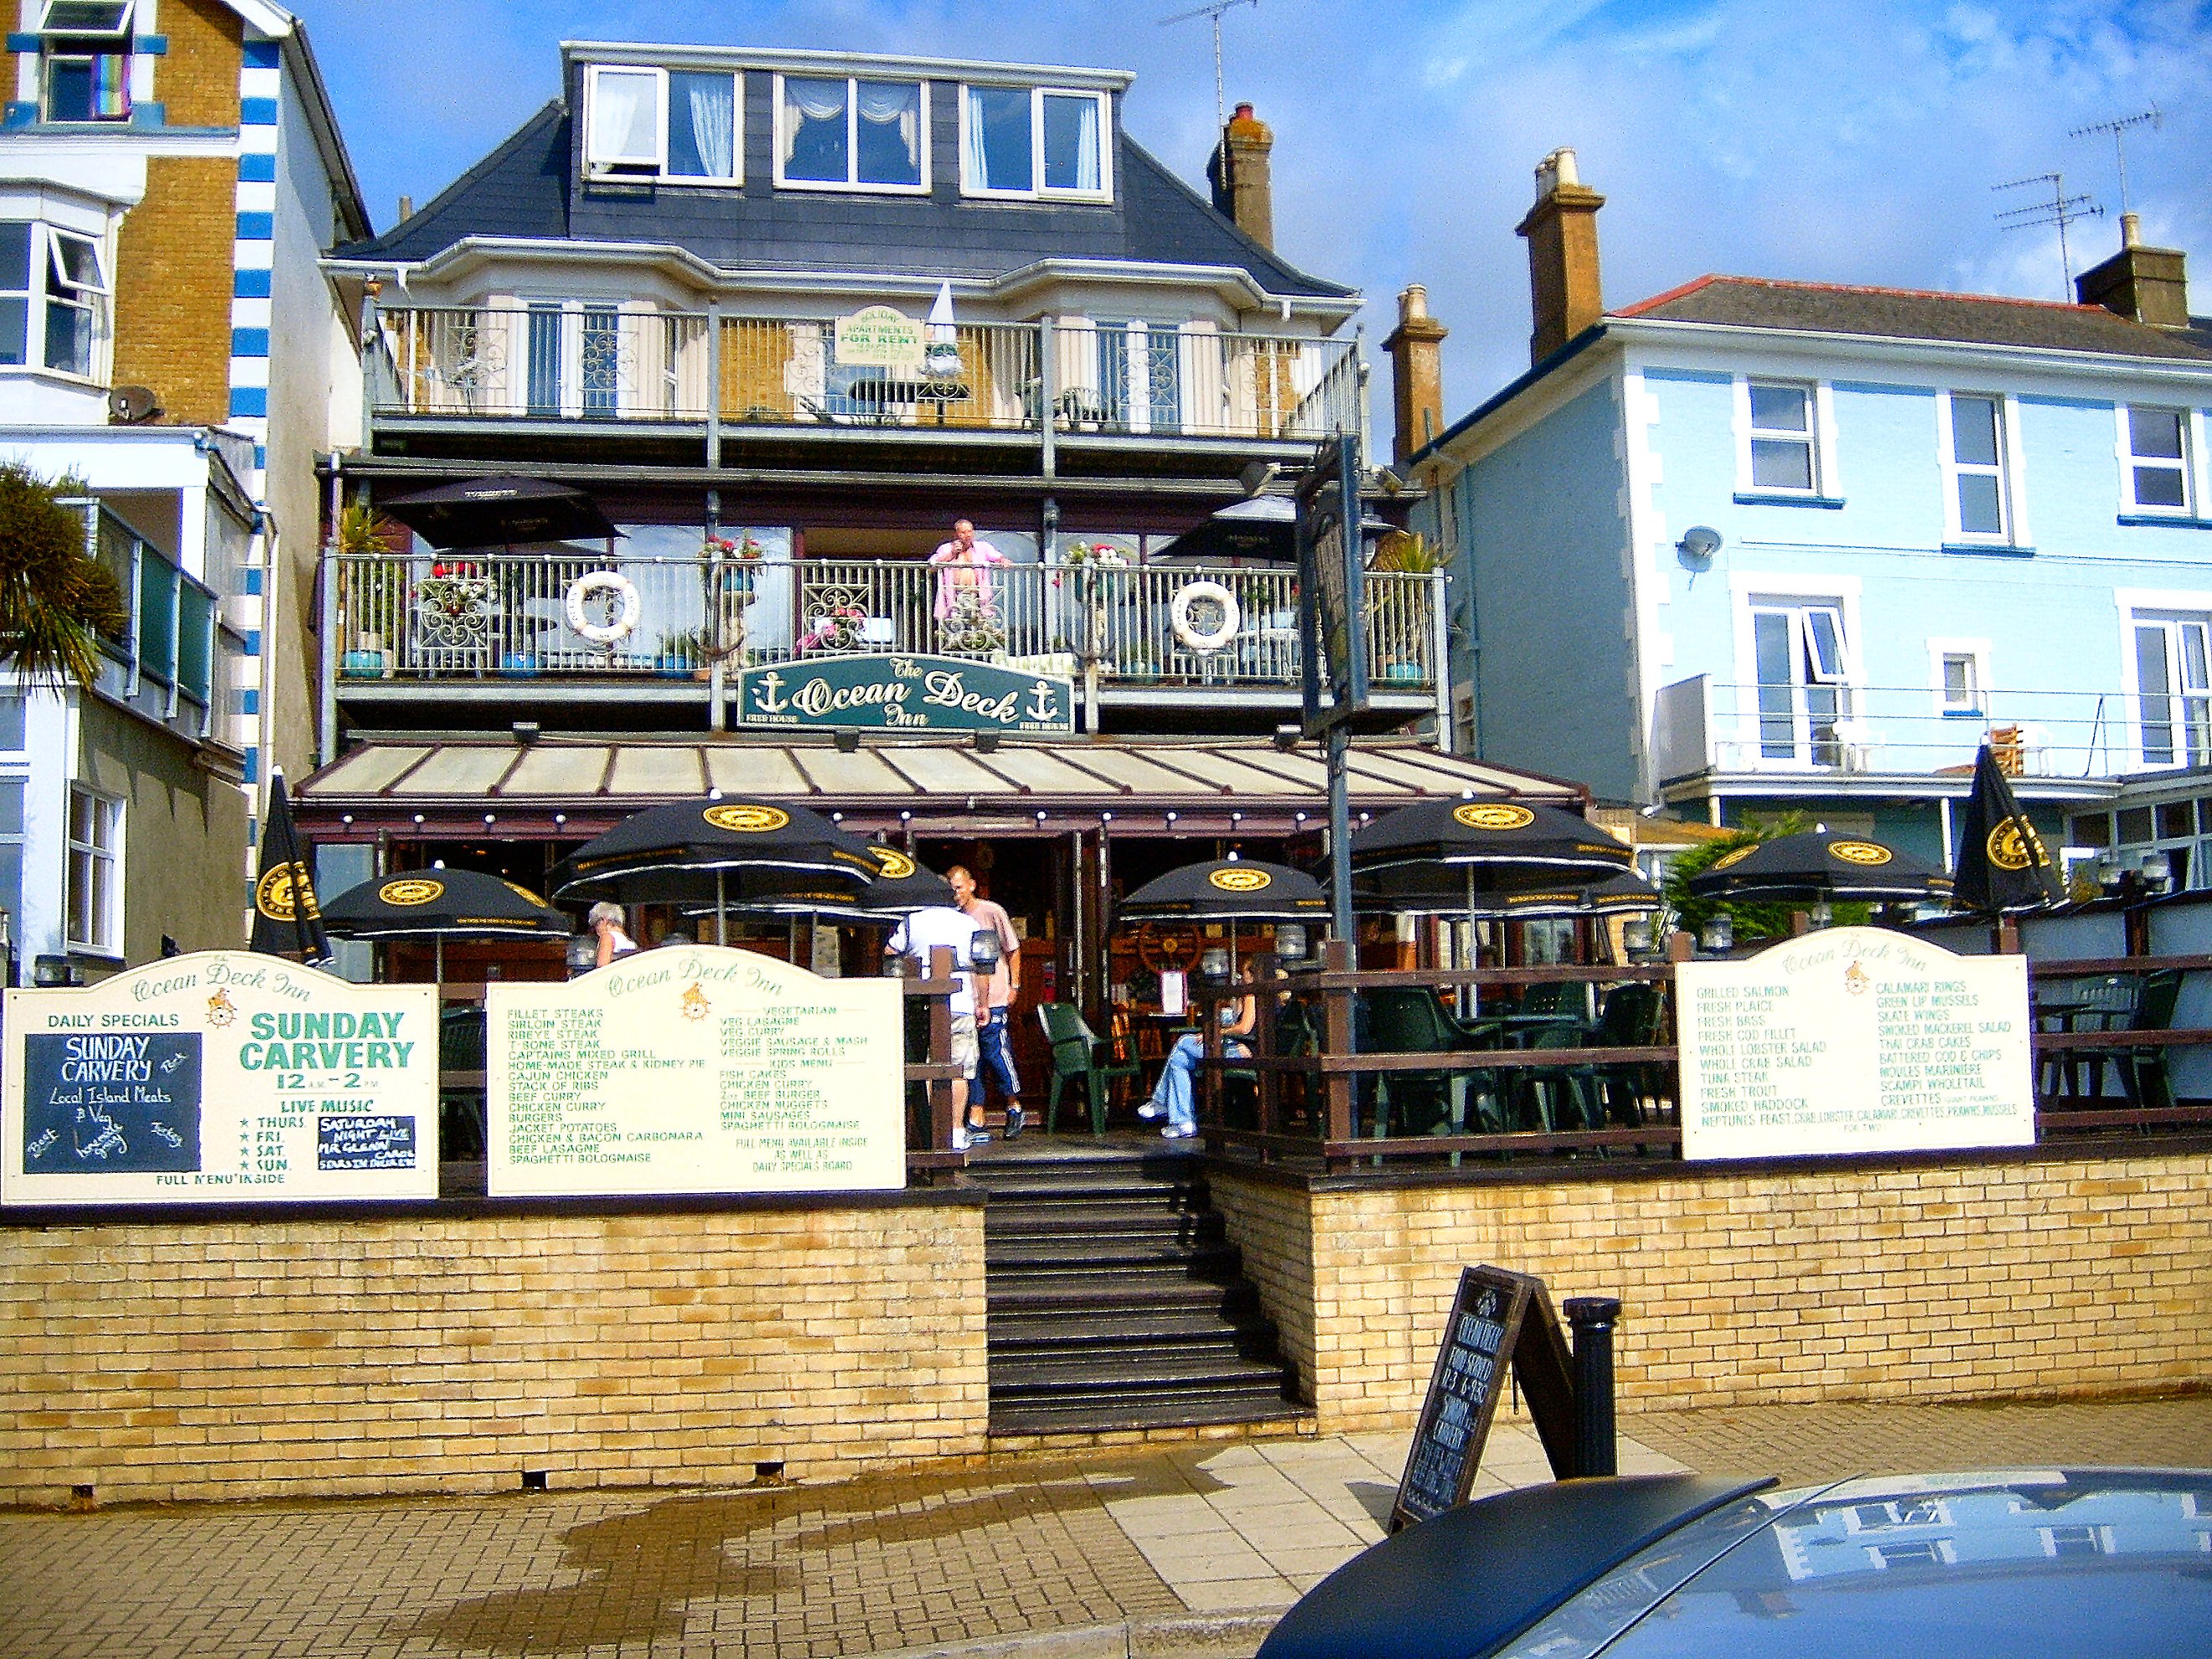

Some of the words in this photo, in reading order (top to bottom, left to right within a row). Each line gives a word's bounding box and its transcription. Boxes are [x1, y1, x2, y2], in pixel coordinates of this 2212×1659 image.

[840, 334, 870, 343] FOR
[877, 335, 918, 344] RENT
[889, 658, 923, 678] The
[791, 677, 912, 717] Ocean
[923, 669, 1020, 725] Deck
[884, 703, 929, 726] Inn
[1842, 939, 1890, 958] Deck
[1897, 947, 1926, 971] Inn
[131, 974, 198, 1002] Ocean
[206, 964, 266, 988] Deck
[272, 973, 313, 1002] Inn
[606, 969, 671, 998] Ocean
[678, 959, 738, 981] Deck
[746, 967, 783, 997] Inn
[1697, 987, 1739, 999] GRILLED
[1744, 986, 1789, 997] SALMON
[762, 1006, 837, 1016] VEGETARIAN
[1697, 1001, 1731, 1013] FRESH
[507, 1009, 548, 1019] FILLET
[555, 1009, 603, 1019] STEAKS
[48, 1015, 94, 1027] DAILY
[101, 1014, 179, 1026] SPECIALS
[251, 1012, 405, 1041] SUNDAY
[508, 1020, 555, 1030] SIRLOIN
[561, 1019, 602, 1029] STEAK
[1736, 1016, 1765, 1026] BASS
[1978, 1021, 2011, 1033] SALAD
[507, 1030, 550, 1040] RIBEYE
[556, 1030, 597, 1039] STEAK
[1698, 1031, 1732, 1041] FRESH
[1738, 1030, 1759, 1041] COD
[561, 1040, 601, 1049] STEAK
[720, 1038, 761, 1047] VEGGIE
[767, 1037, 819, 1047] SAUSAGE
[835, 1036, 867, 1046] MASH
[65, 1036, 151, 1061] SUNDAY
[720, 1048, 761, 1057] VEGGIE
[767, 1047, 804, 1057] SPRING
[810, 1047, 845, 1056] ROLLS
[1741, 1043, 1787, 1055] LOBSTER
[1791, 1041, 1827, 1053] SALAD
[239, 1041, 415, 1071] CARVERY
[576, 1050, 615, 1060] MIXED
[621, 1049, 656, 1059] GRILL
[1972, 1049, 2002, 1061] CHIPS
[507, 1061, 582, 1071] HOME-MADE
[587, 1060, 626, 1070] STEAK
[643, 1060, 685, 1069] KIDNEY
[689, 1059, 706, 1068] PIE
[769, 1060, 795, 1069] KIDS
[800, 1059, 833, 1068] MENU
[1776, 1056, 1812, 1067] SALAD
[62, 1060, 152, 1082] CARVERY
[508, 1072, 550, 1081] CAJUN
[556, 1071, 608, 1081] CHICKEN
[720, 1070, 744, 1079] FISH
[749, 1070, 787, 1079] CAKES
[276, 1073, 306, 1089] 12
[344, 1072, 361, 1088] 2
[1701, 1073, 1730, 1084] TUNA
[1734, 1072, 1769, 1083] STEAK
[509, 1082, 546, 1092] STACK
[552, 1082, 567, 1091] OF
[572, 1081, 599, 1091] RIBS
[720, 1080, 769, 1090] CHICKEN
[774, 1080, 813, 1089] CURRY
[49, 1087, 83, 1104] Local
[87, 1087, 130, 1103] Island
[134, 1086, 172, 1103] Meats
[509, 1093, 537, 1102] BEEF
[543, 1092, 581, 1102] CURRY
[744, 1091, 770, 1099] BEEF
[775, 1090, 820, 1099] BURGER
[1701, 1087, 1736, 1098] FRESH
[1741, 1085, 1777, 1097] TROUT
[720, 1101, 769, 1110] CHICKEN
[774, 1100, 828, 1109] NUGGETS
[1702, 1101, 1748, 1113] SMOKED
[1754, 1098, 1809, 1111] HADDOCK
[1881, 1093, 1941, 1106] CREVETTES
[281, 1099, 316, 1114] LIVE
[320, 1098, 375, 1114] MUSIC
[509, 1103, 561, 1113] CHICKEN
[566, 1102, 607, 1112] CURRY
[509, 1113, 562, 1123] BURGERS
[720, 1112, 745, 1120] MINI
[751, 1111, 810, 1120] SAUSAGES
[257, 1116, 308, 1129] THURS.
[320, 1118, 396, 1132] SATURDAY
[509, 1124, 554, 1133] JACKET
[560, 1123, 618, 1133] POTATOES
[721, 1122, 783, 1131] SPAGHETTI
[788, 1121, 860, 1130] BOLOGNAISE
[256, 1131, 286, 1143] FRI.
[333, 1129, 378, 1144] NIGHT
[509, 1134, 561, 1144] CHICKEN
[579, 1133, 622, 1143] BACON
[627, 1132, 703, 1142] CARBONARA
[736, 1139, 756, 1149] FULL
[759, 1138, 783, 1149] MENU
[788, 1138, 835, 1148] AVAILABLE
[839, 1137, 868, 1147] INSIDE
[257, 1145, 286, 1157] SAT.
[509, 1145, 537, 1155] BEEF
[543, 1145, 600, 1154] LASAGNE
[774, 1150, 786, 1160] AS
[790, 1150, 813, 1160] WELL
[816, 1150, 828, 1160] AS
[257, 1159, 292, 1171] SUN.
[509, 1155, 574, 1165] SPAGHETTI
[578, 1153, 651, 1163] BOLOGNAISE
[753, 1162, 777, 1173] DAILY
[780, 1161, 819, 1172] SPECIALS
[823, 1161, 852, 1171] BOARD
[156, 1175, 189, 1185] FULL
[194, 1175, 233, 1185] MENU
[239, 1174, 285, 1184] INSIDE
